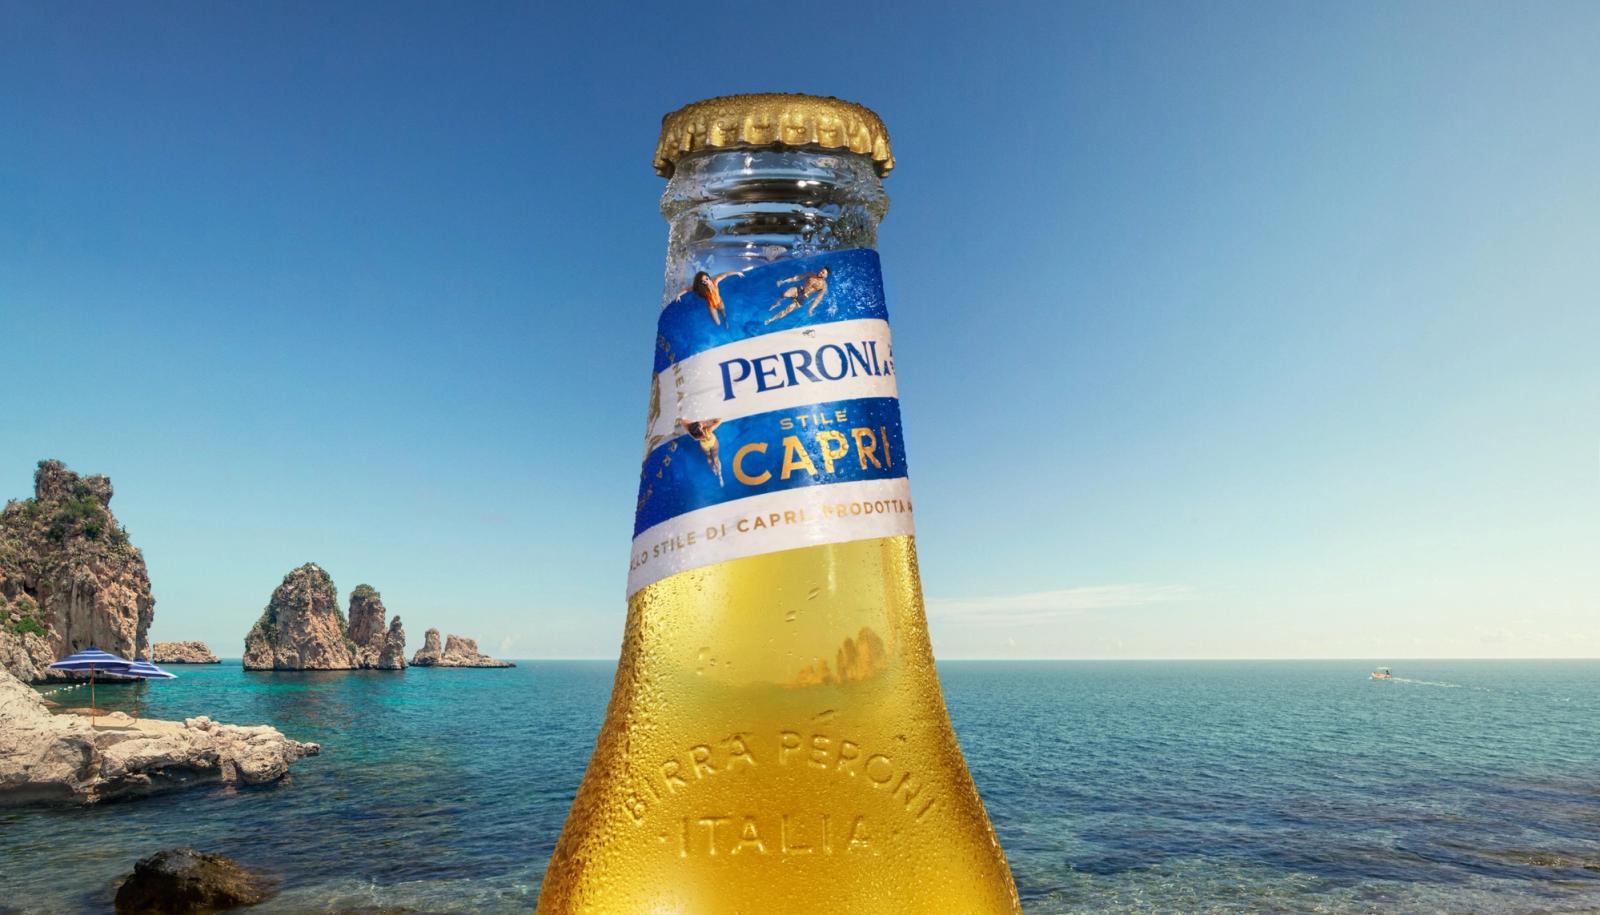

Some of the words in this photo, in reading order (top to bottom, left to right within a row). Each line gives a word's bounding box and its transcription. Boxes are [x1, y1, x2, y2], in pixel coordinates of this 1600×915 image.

[719, 340, 881, 401] PERONI
[779, 408, 848, 430] STILE
[732, 426, 892, 486] CAPRI
[653, 532, 697, 559] STILE
[706, 525, 727, 541] DI
[737, 508, 805, 534] CAPRI
[824, 499, 906, 520] PRODOTTA
[622, 731, 757, 825] BIRRA
[778, 730, 937, 819] PERONI
[679, 814, 878, 859] ITALIA
